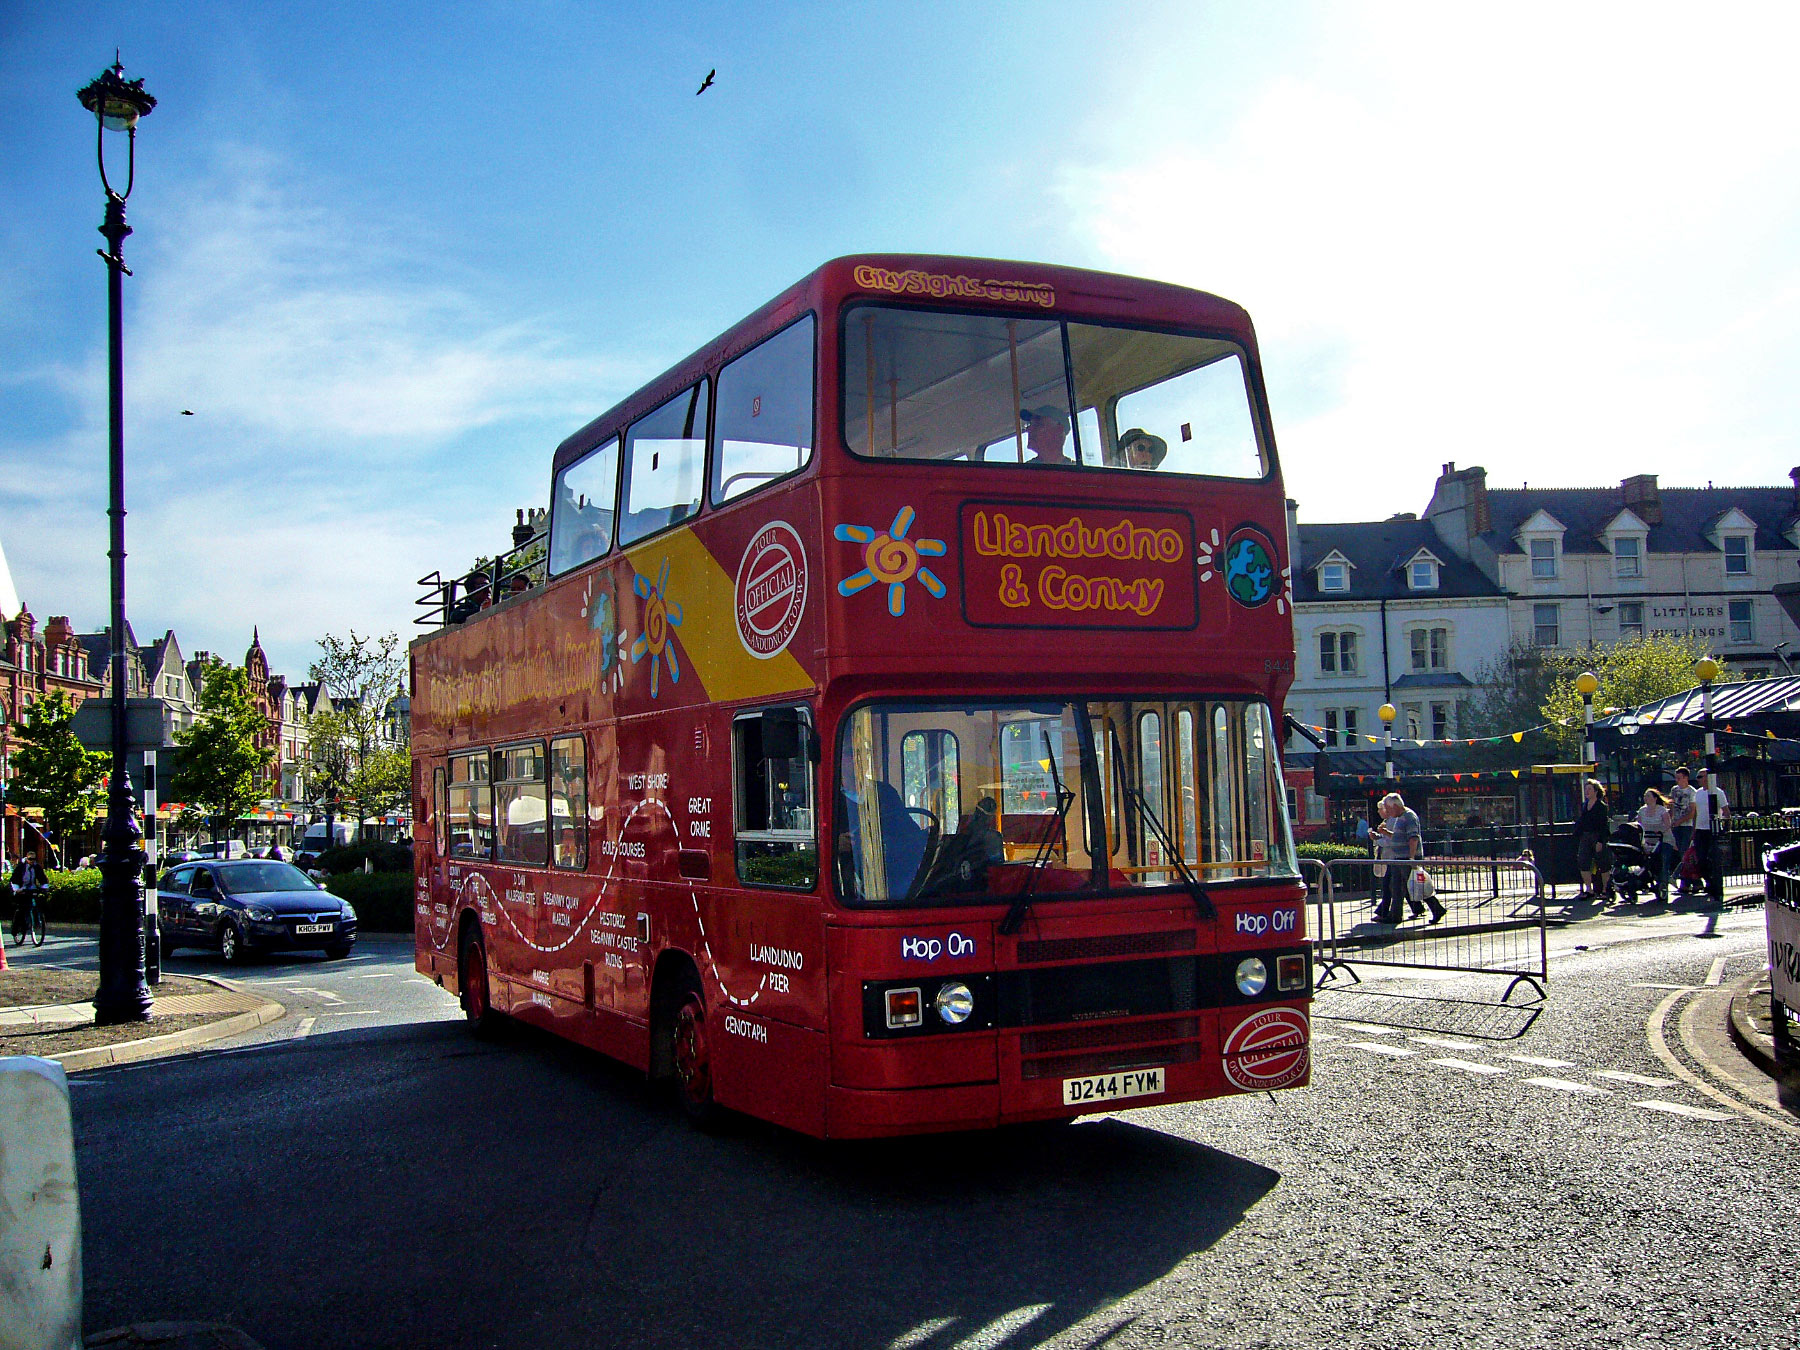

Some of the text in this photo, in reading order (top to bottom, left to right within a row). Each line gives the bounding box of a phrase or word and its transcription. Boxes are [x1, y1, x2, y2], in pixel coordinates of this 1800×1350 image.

[854, 265, 1055, 308] CitySightseeing
[755, 529, 777, 553] TOUR
[974, 511, 1184, 562] Llandudno
[748, 566, 793, 610] OFFICIAL
[999, 564, 1164, 616] & Conwy
[744, 624, 783, 651] LLANDUDNO
[783, 625, 790, 638] &
[1264, 658, 1290, 674] 844
[628, 773, 668, 790] WEST SHORE
[688, 797, 712, 814] GREAT
[690, 820, 711, 838] ORME
[602, 840, 646, 858] GOLF COURSES
[599, 911, 626, 929] HISTORIC
[1236, 910, 1296, 935] Hop Off
[590, 929, 638, 953] DEGANWY CASTLE
[902, 932, 975, 961] Hop On
[605, 951, 623, 969] RUINS
[750, 943, 803, 971] LLANDUDNO
[769, 971, 790, 994] PIER
[725, 1015, 767, 1044] CENOTAPH
[1252, 1013, 1281, 1028] TOUR
[1229, 1060, 1239, 1074] OF
[1237, 1072, 1289, 1087] LLANDUDNO
[1290, 1071, 1297, 1079] &
[1070, 1071, 1158, 1101] D244 FYM
